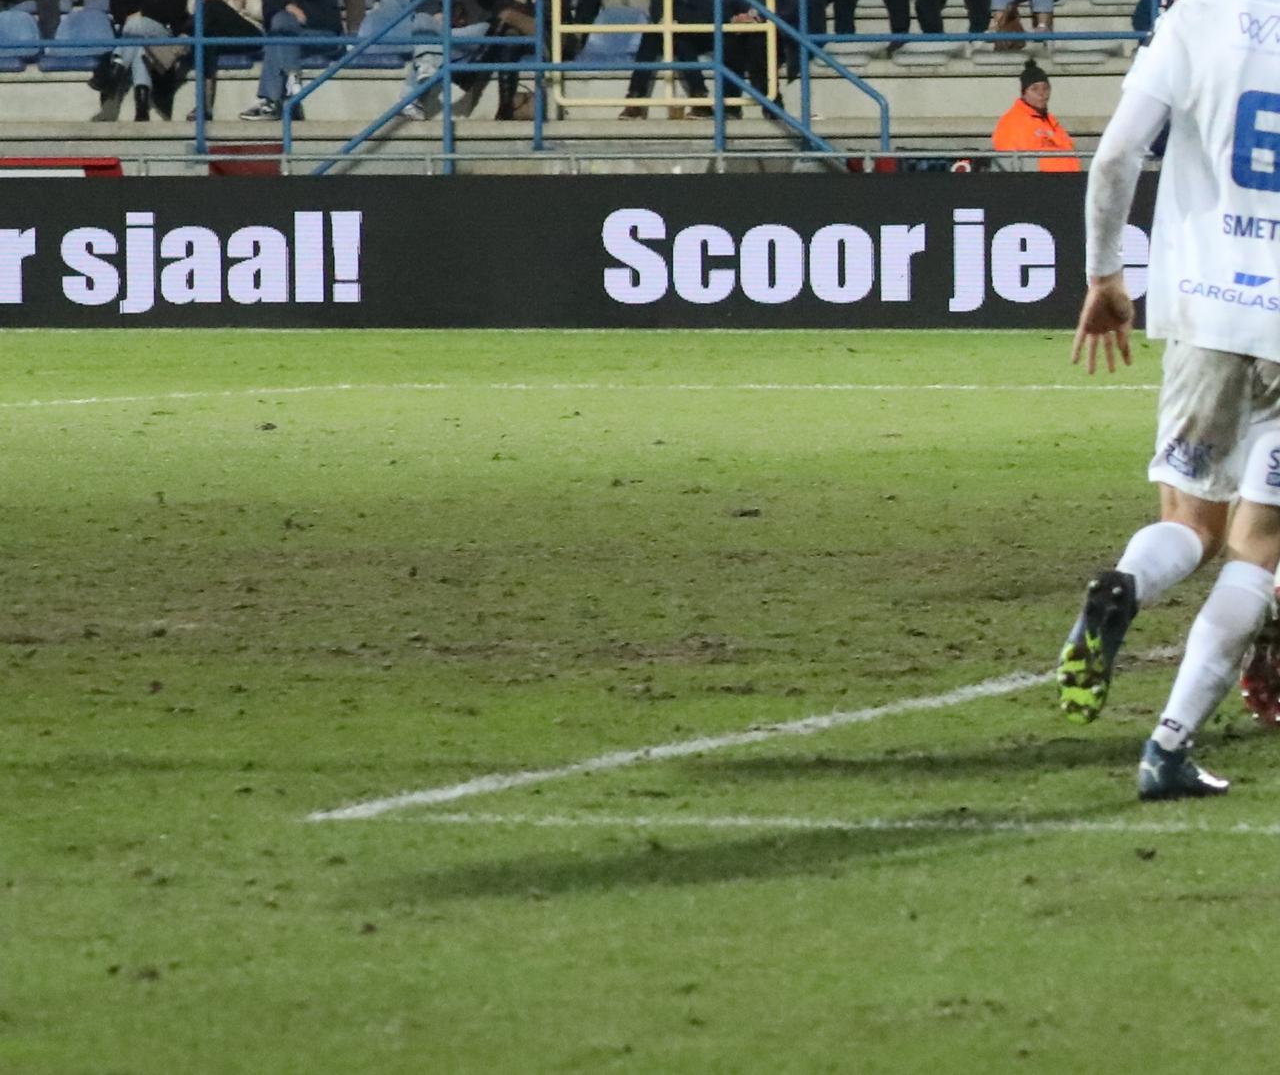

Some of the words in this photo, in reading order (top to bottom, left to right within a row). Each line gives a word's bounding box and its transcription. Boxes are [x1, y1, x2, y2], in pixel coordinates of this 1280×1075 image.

[61, 210, 362, 313] sjaal!
[600, 208, 925, 304] Scoor
[947, 209, 1056, 312] je
